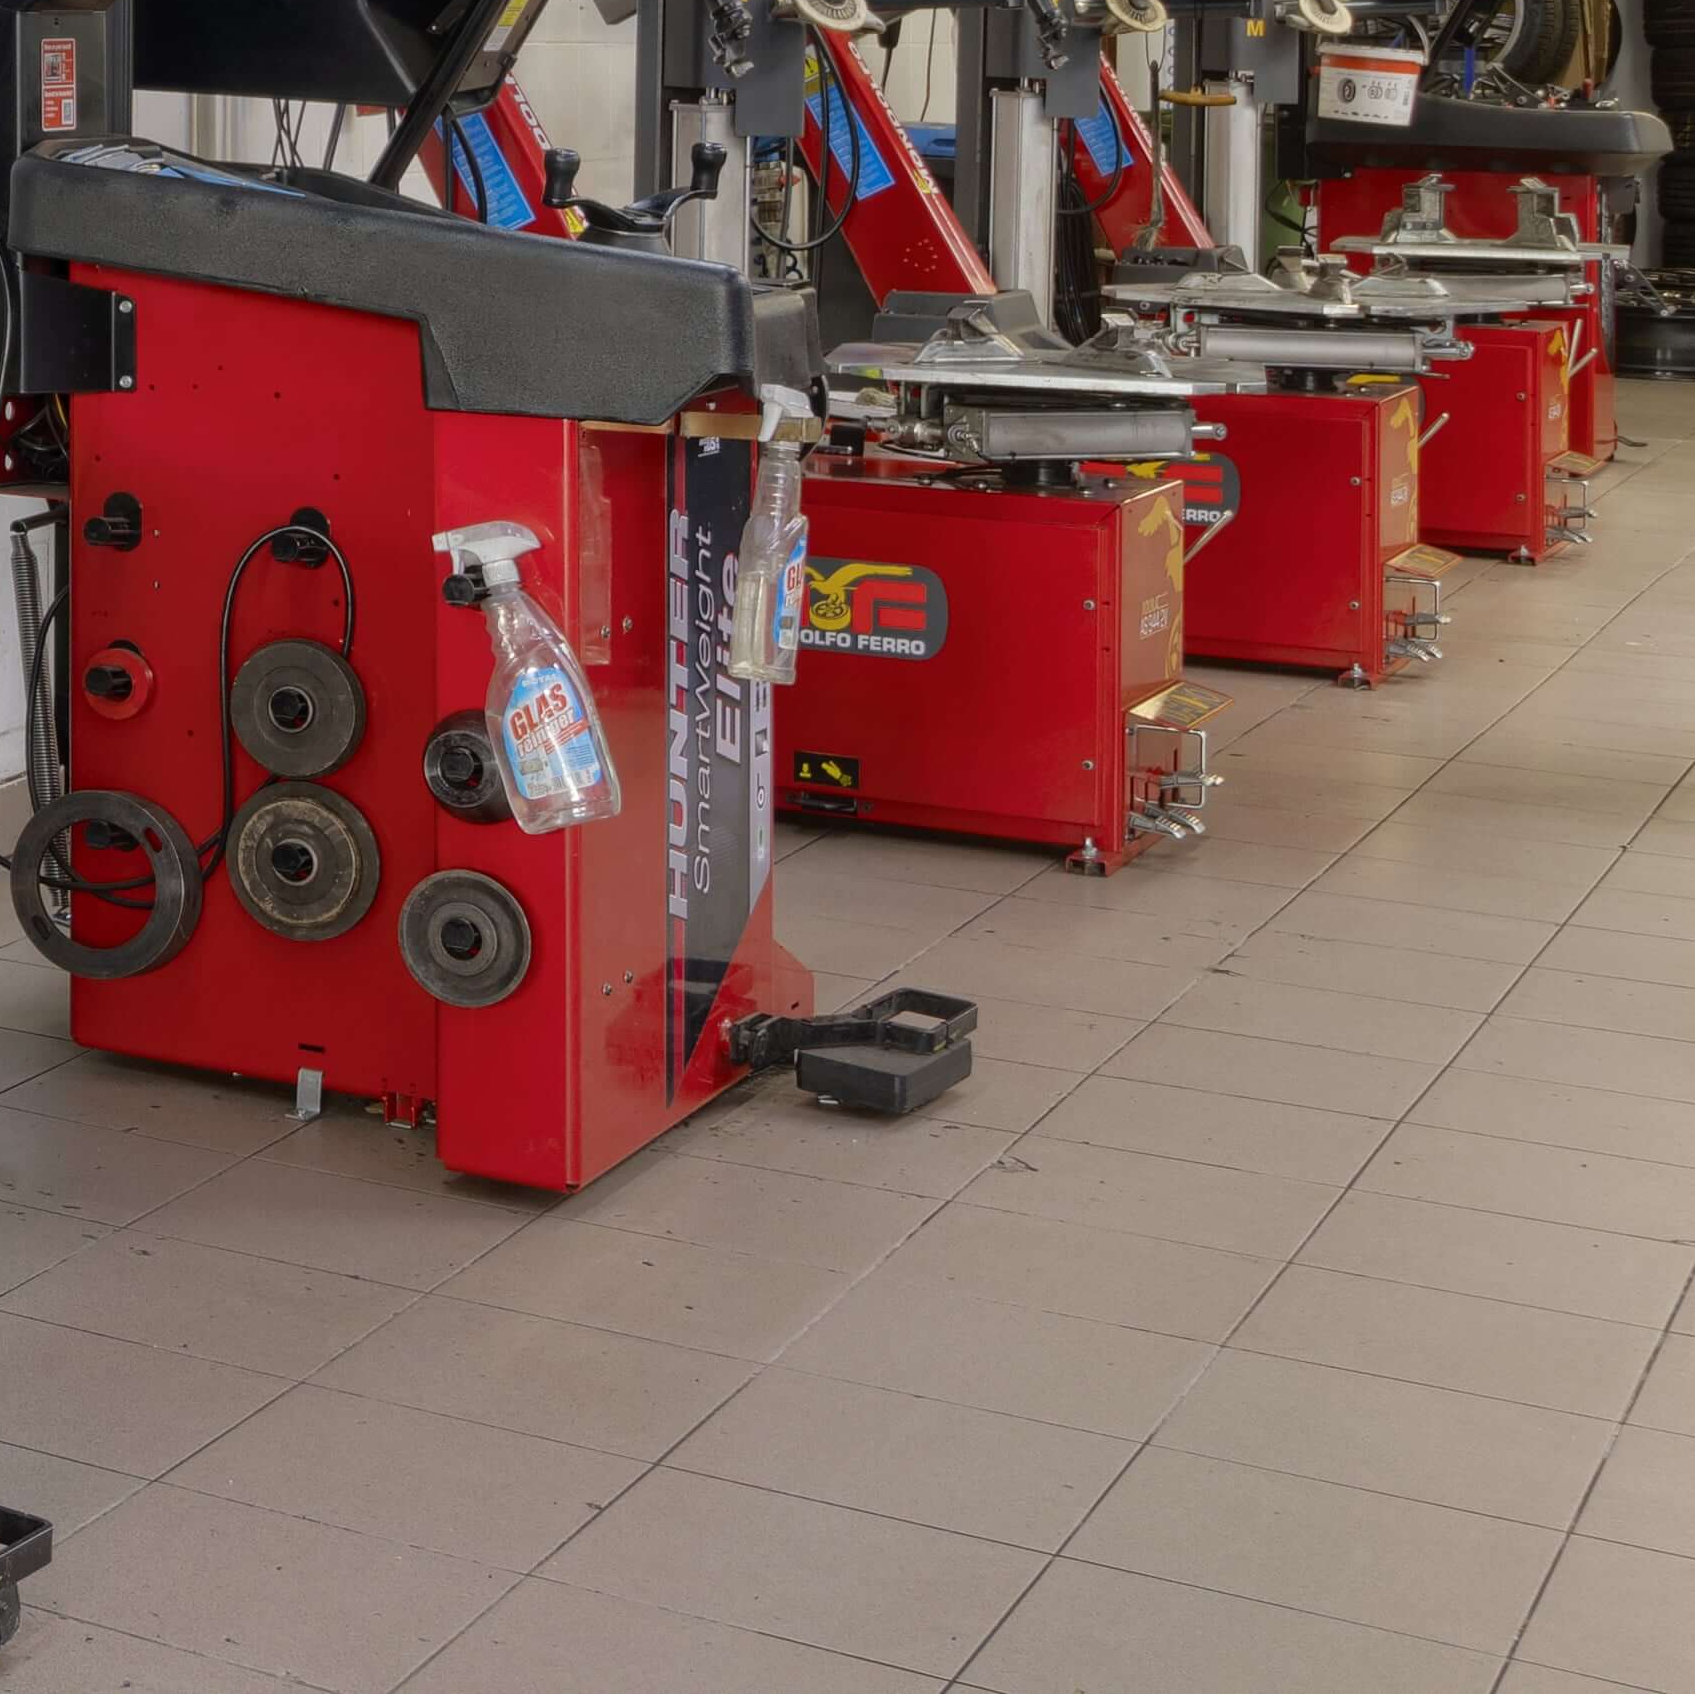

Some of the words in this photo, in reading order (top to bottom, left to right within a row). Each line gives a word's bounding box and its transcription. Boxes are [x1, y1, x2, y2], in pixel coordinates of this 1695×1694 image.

[510, 682, 567, 740] GLAS
[667, 509, 691, 920] HUNTER
[692, 525, 713, 895] SmartWeight
[714, 550, 742, 764] Elite
[857, 635, 926, 656] FERRO
